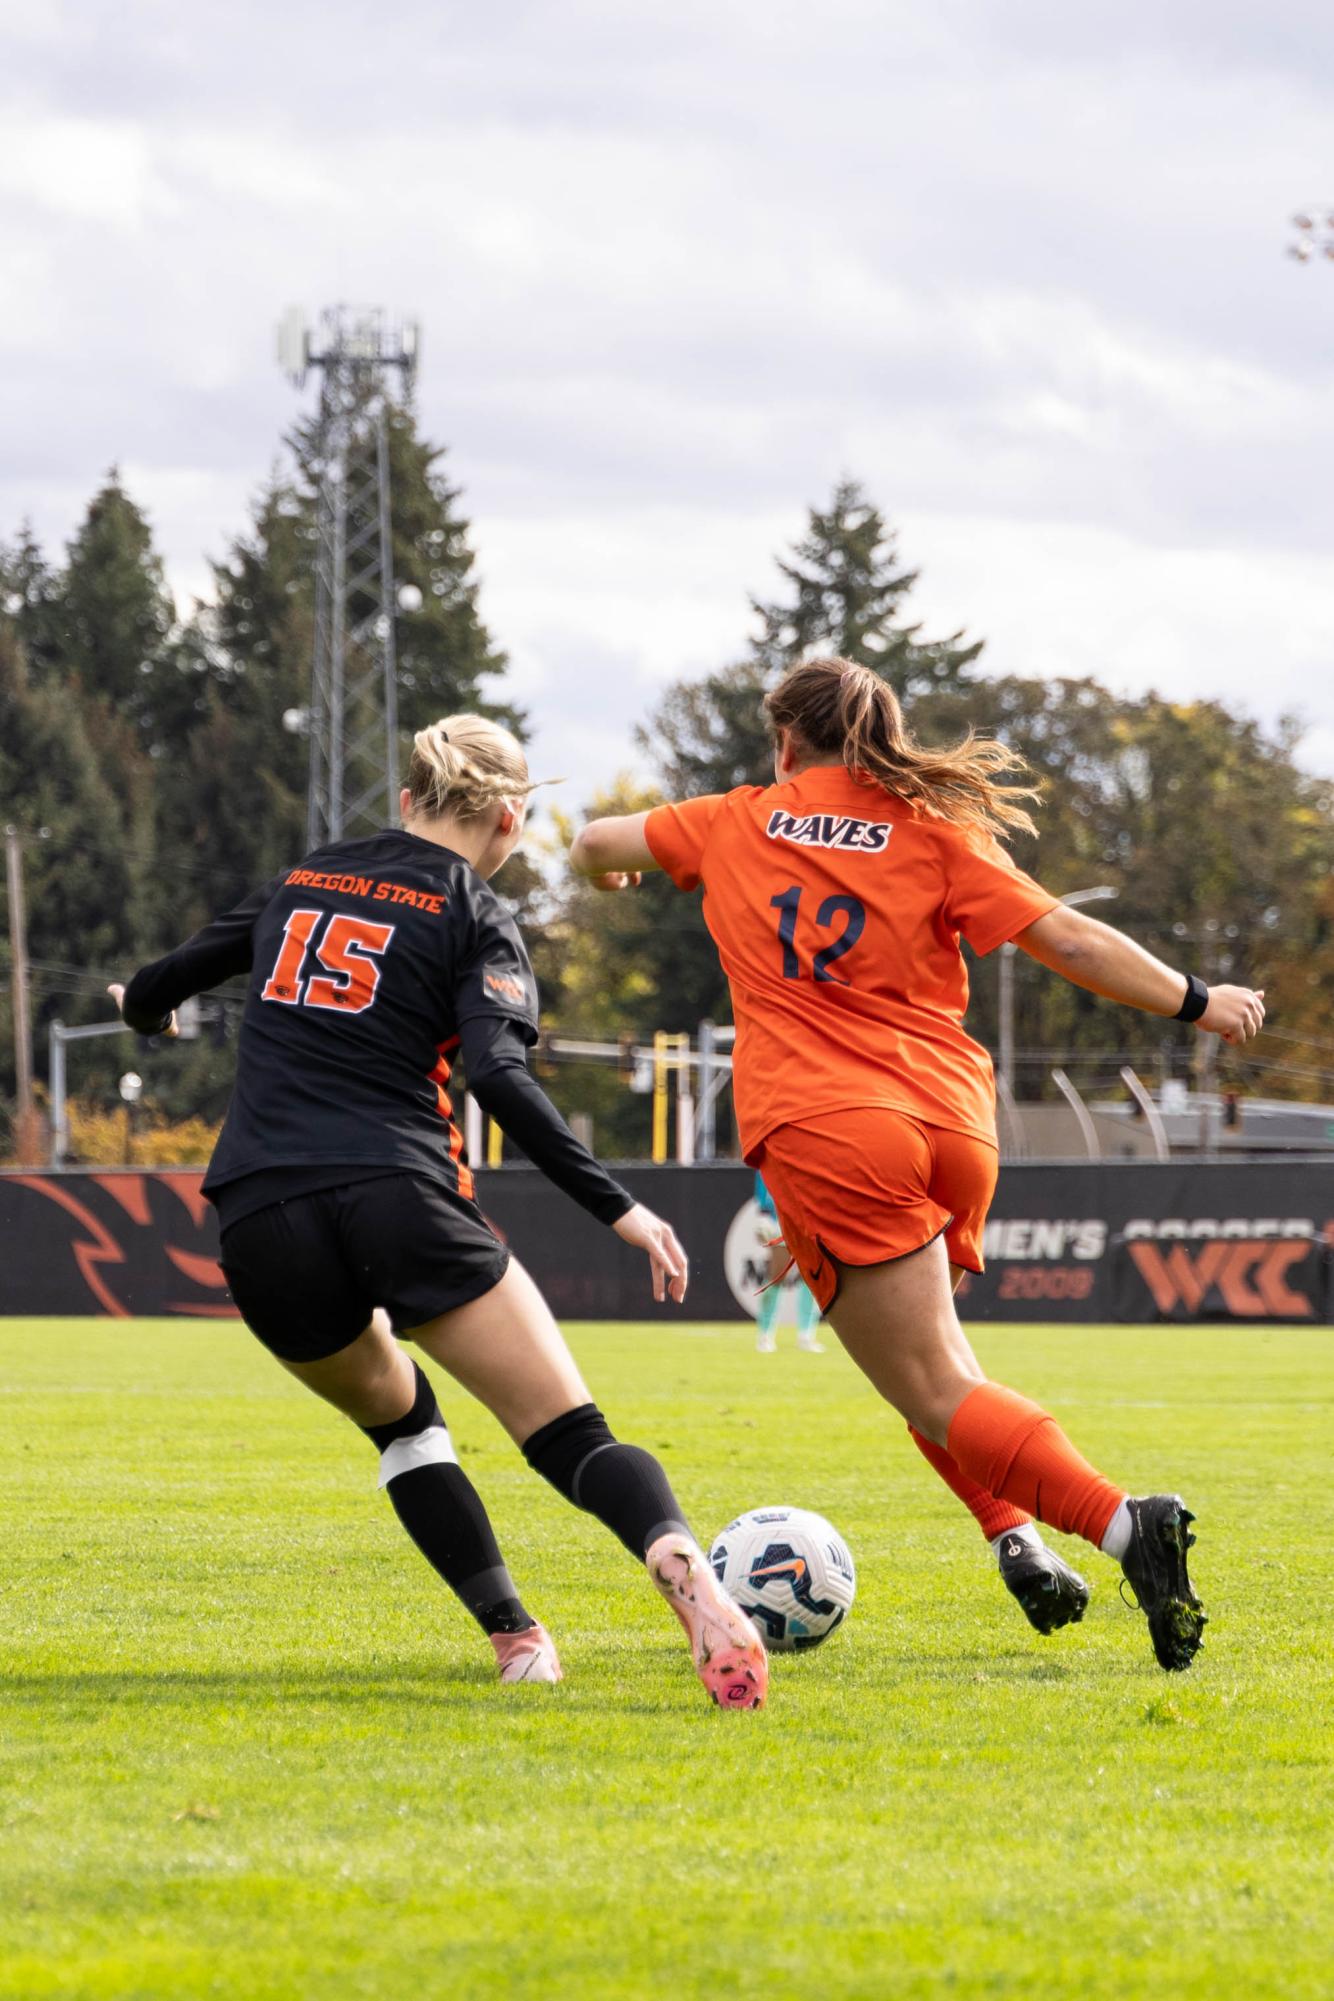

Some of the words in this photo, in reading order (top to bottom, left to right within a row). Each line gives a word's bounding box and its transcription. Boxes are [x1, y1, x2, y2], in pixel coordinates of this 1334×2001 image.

[766, 810, 893, 853] WAVES
[285, 870, 374, 897] OREGON
[372, 882, 446, 914] STATE
[261, 909, 396, 1014] 15
[769, 885, 867, 987] 12
[1126, 1240, 1314, 1317] WCC
